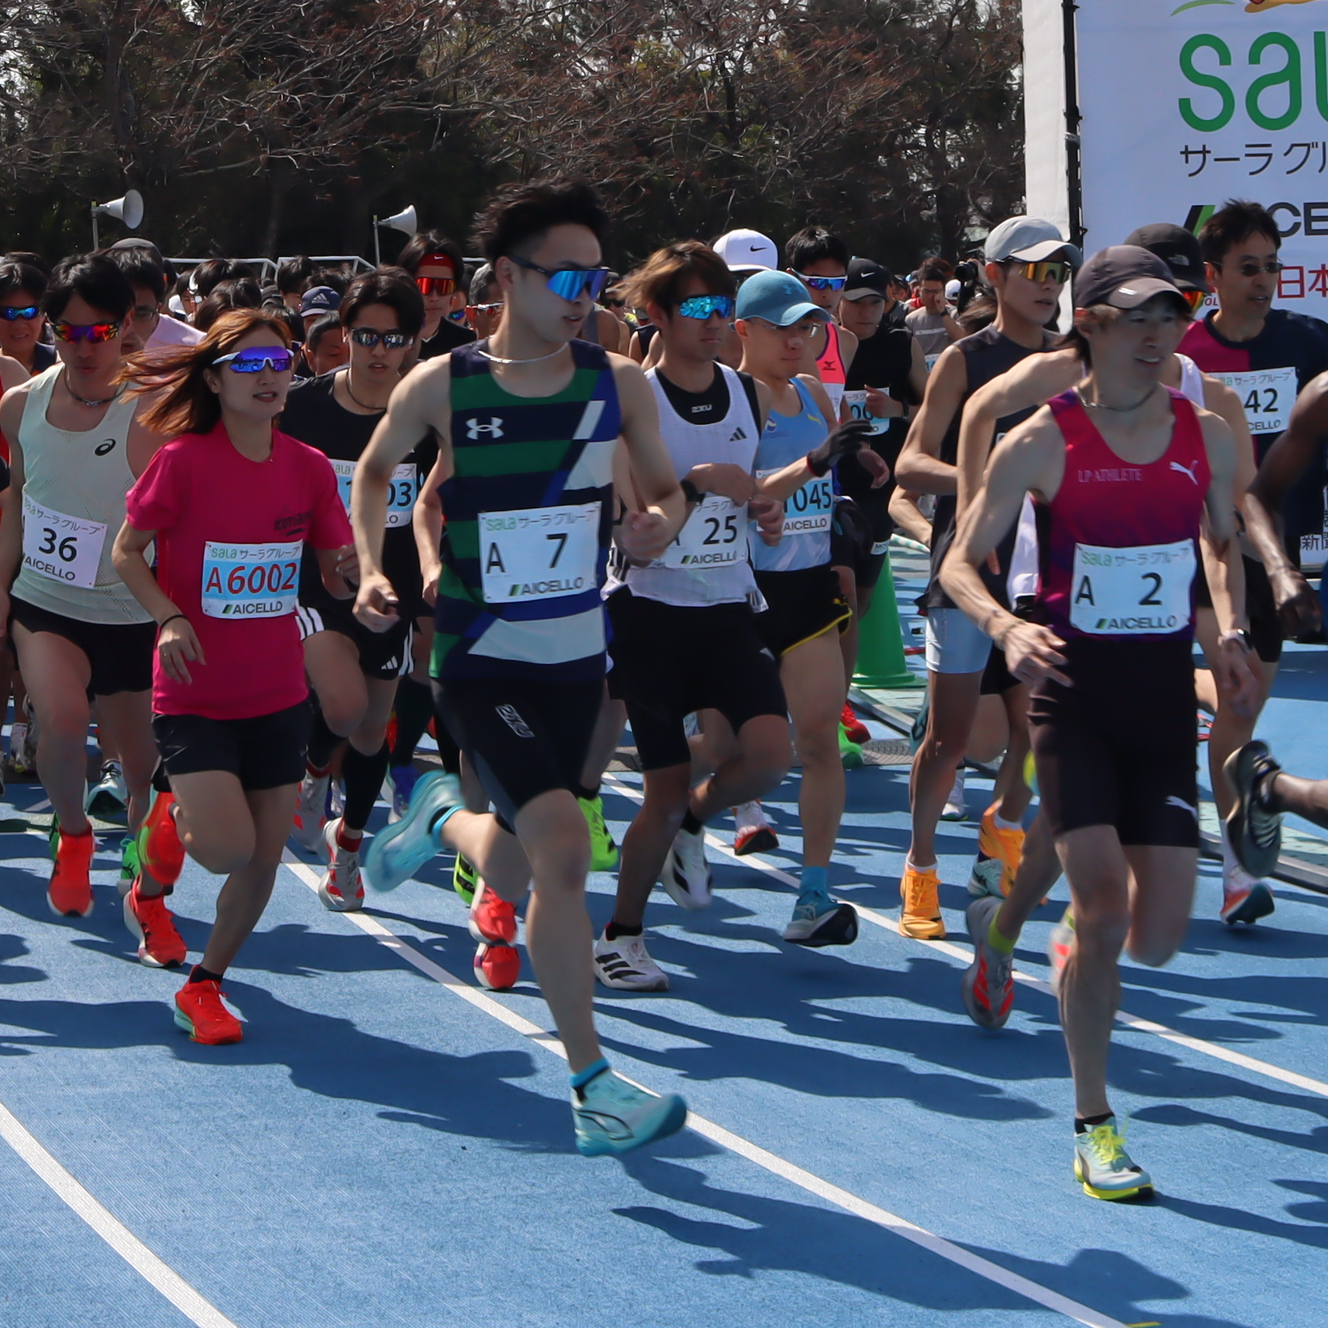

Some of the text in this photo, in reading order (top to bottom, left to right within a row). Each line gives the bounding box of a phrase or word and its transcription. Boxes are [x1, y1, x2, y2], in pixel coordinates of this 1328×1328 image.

[1243, 387, 1279, 414] 42
[1246, 419, 1281, 431] CELLO
[702, 514, 738, 546] 25
[783, 518, 828, 532] AICELLO
[38, 527, 78, 562] 36
[485, 532, 568, 575] A 7
[24, 556, 76, 582] AICELLO
[520, 576, 585, 596] AICELLO
[1074, 572, 1163, 607] A 2
[232, 600, 283, 615] AICELLO
[1107, 615, 1178, 630] AICELLO
